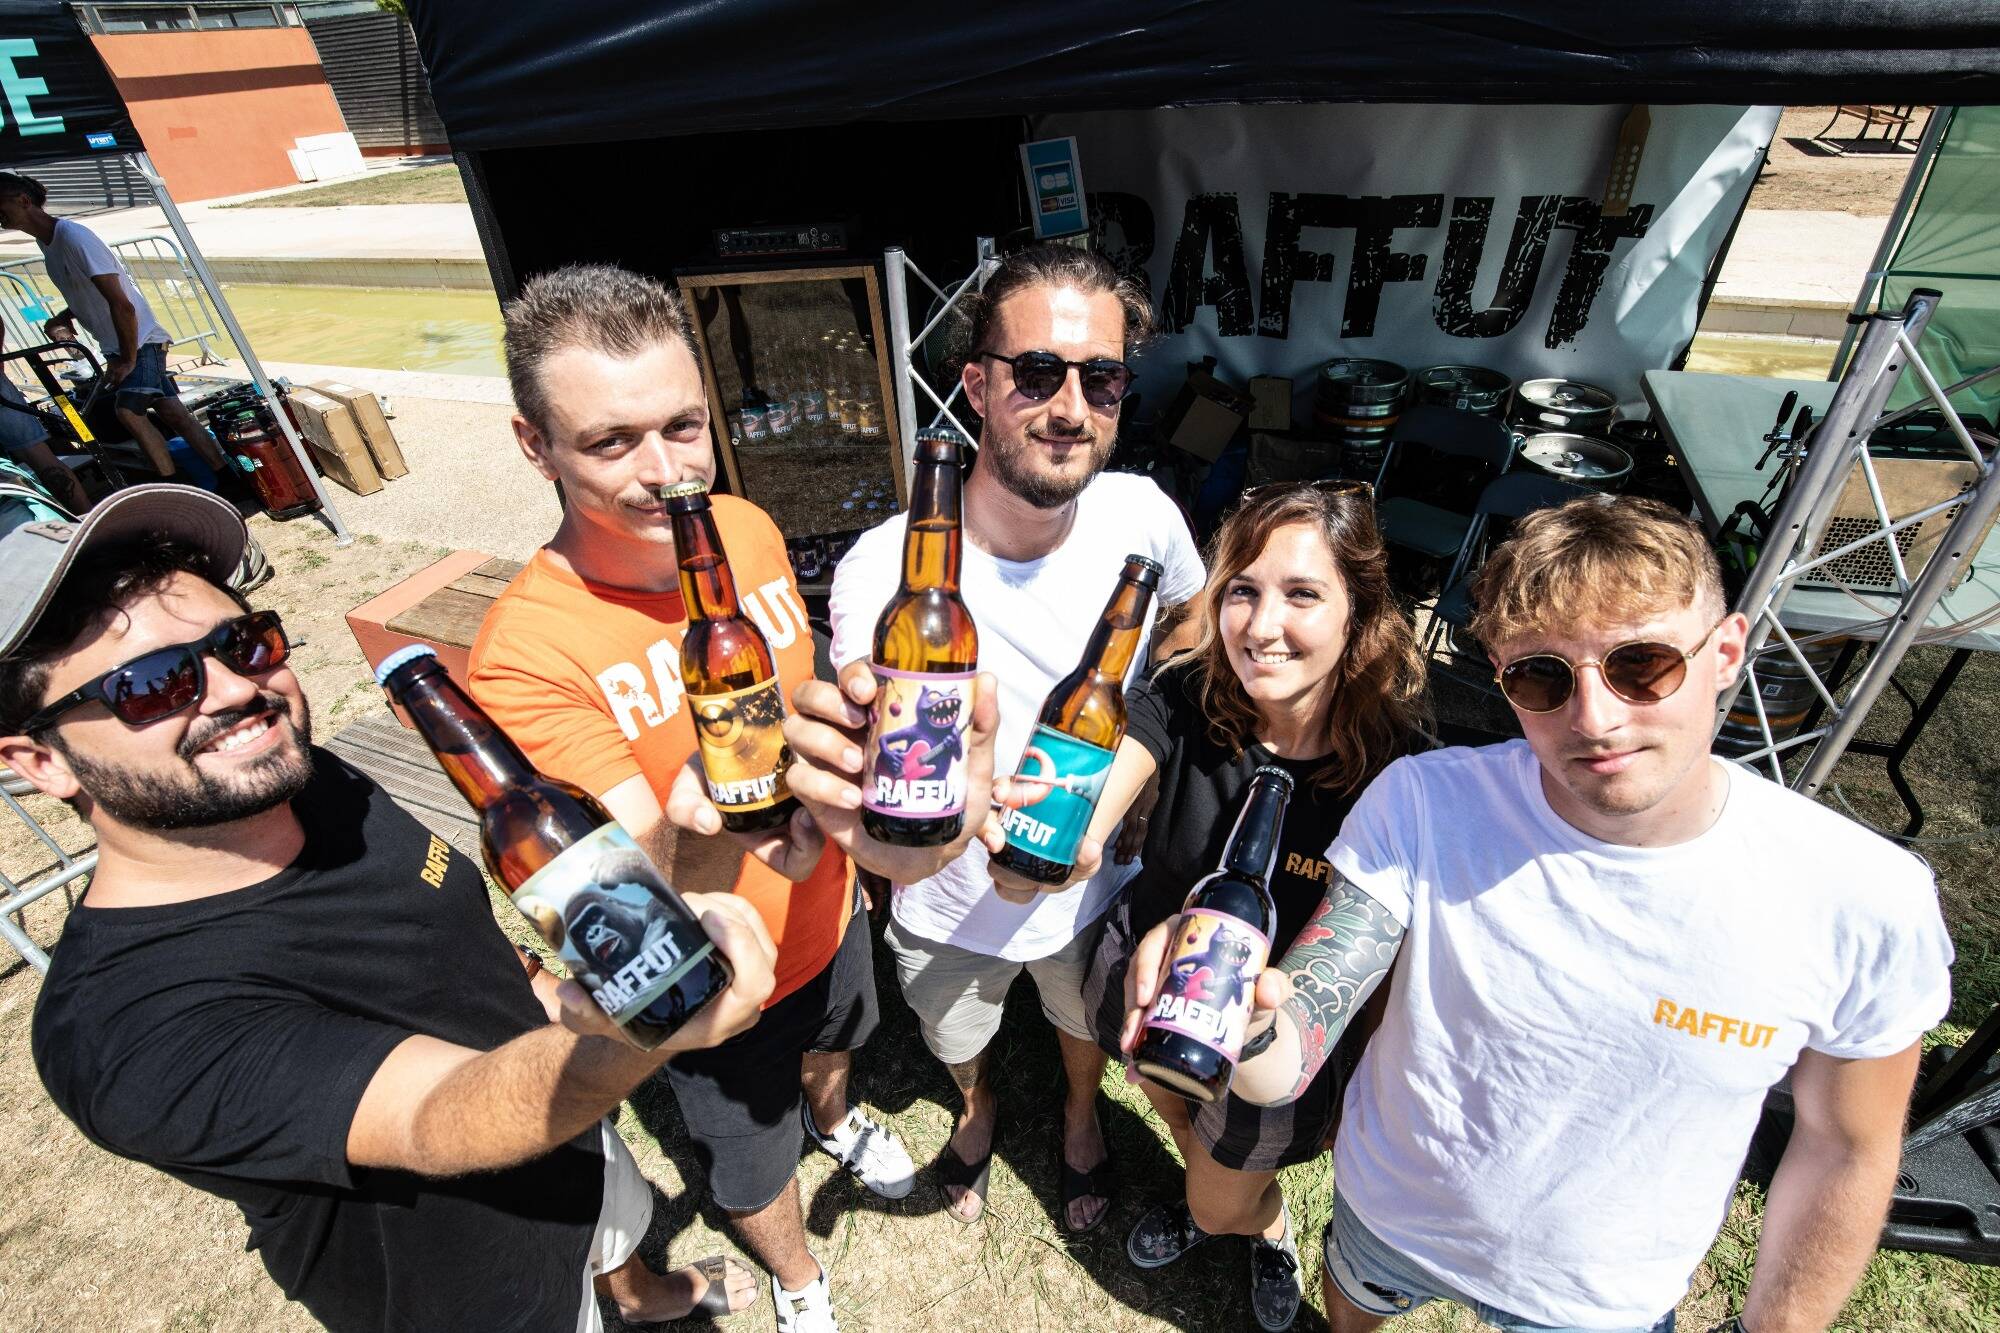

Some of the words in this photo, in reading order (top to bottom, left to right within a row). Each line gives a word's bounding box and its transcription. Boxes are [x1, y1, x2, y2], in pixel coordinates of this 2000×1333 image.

[0, 38, 65, 136] E
[596, 575, 808, 742] RAUT
[1653, 998, 1779, 1048] RAFFUT
